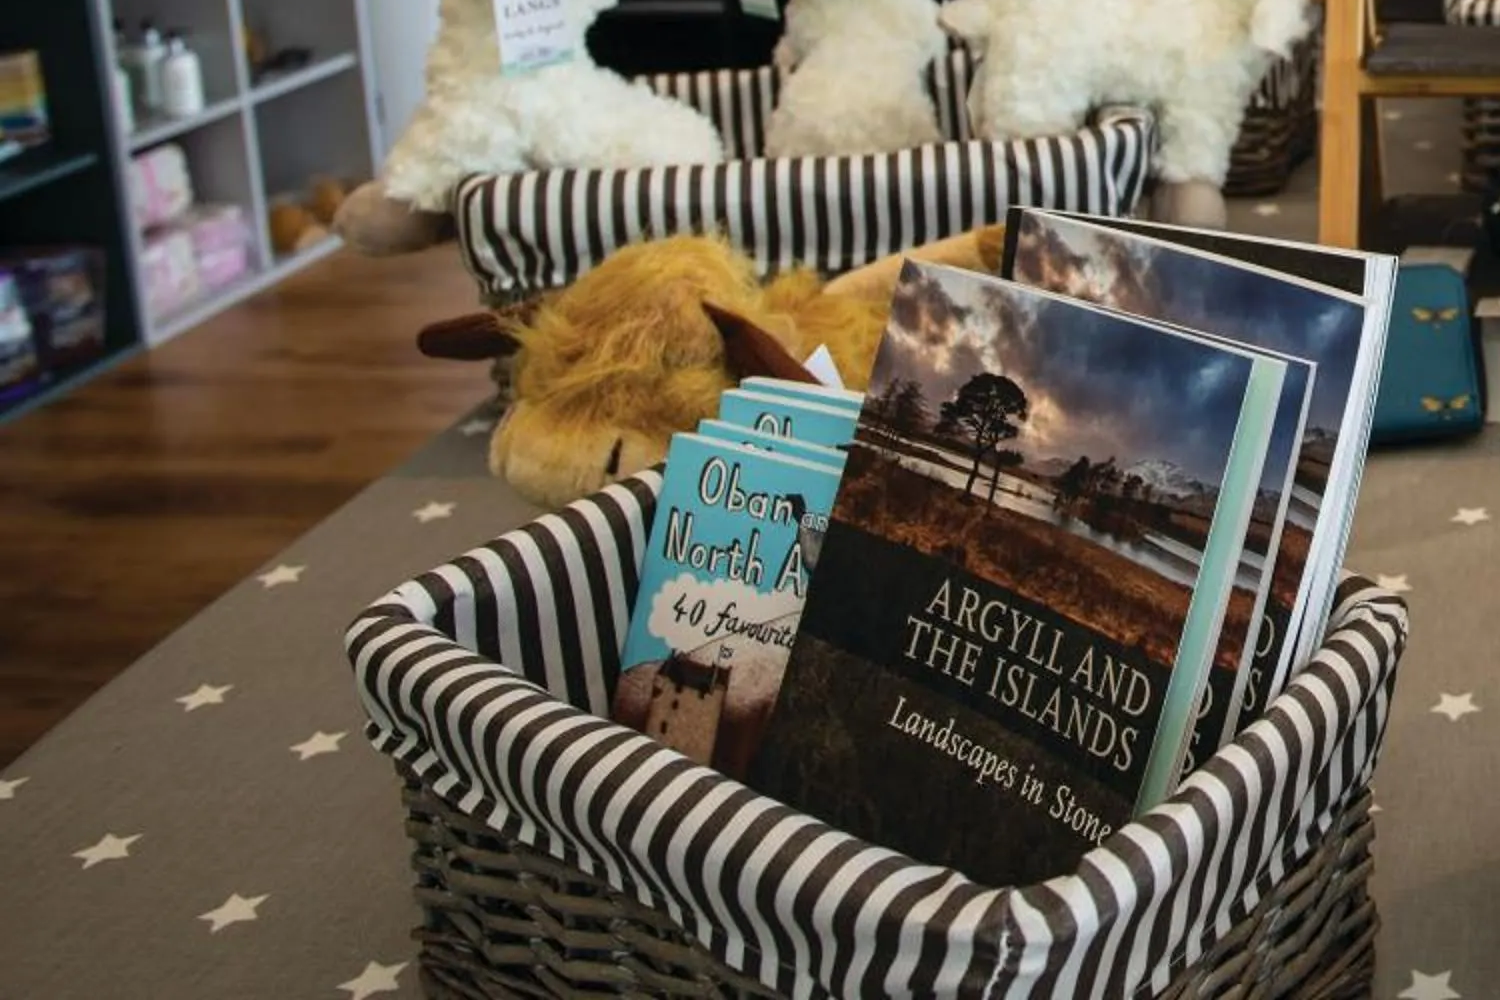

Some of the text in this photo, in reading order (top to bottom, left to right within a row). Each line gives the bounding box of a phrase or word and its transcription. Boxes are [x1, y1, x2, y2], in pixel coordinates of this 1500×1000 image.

[664, 506, 765, 587] North
[699, 453, 829, 536] Oban an
[672, 592, 707, 628] 40
[924, 577, 1065, 675] ARGYLL
[1071, 645, 1152, 716] AND
[903, 614, 983, 688] THE
[986, 656, 1141, 772] ISLANDS
[887, 695, 1112, 846] Landscapes in Stone
